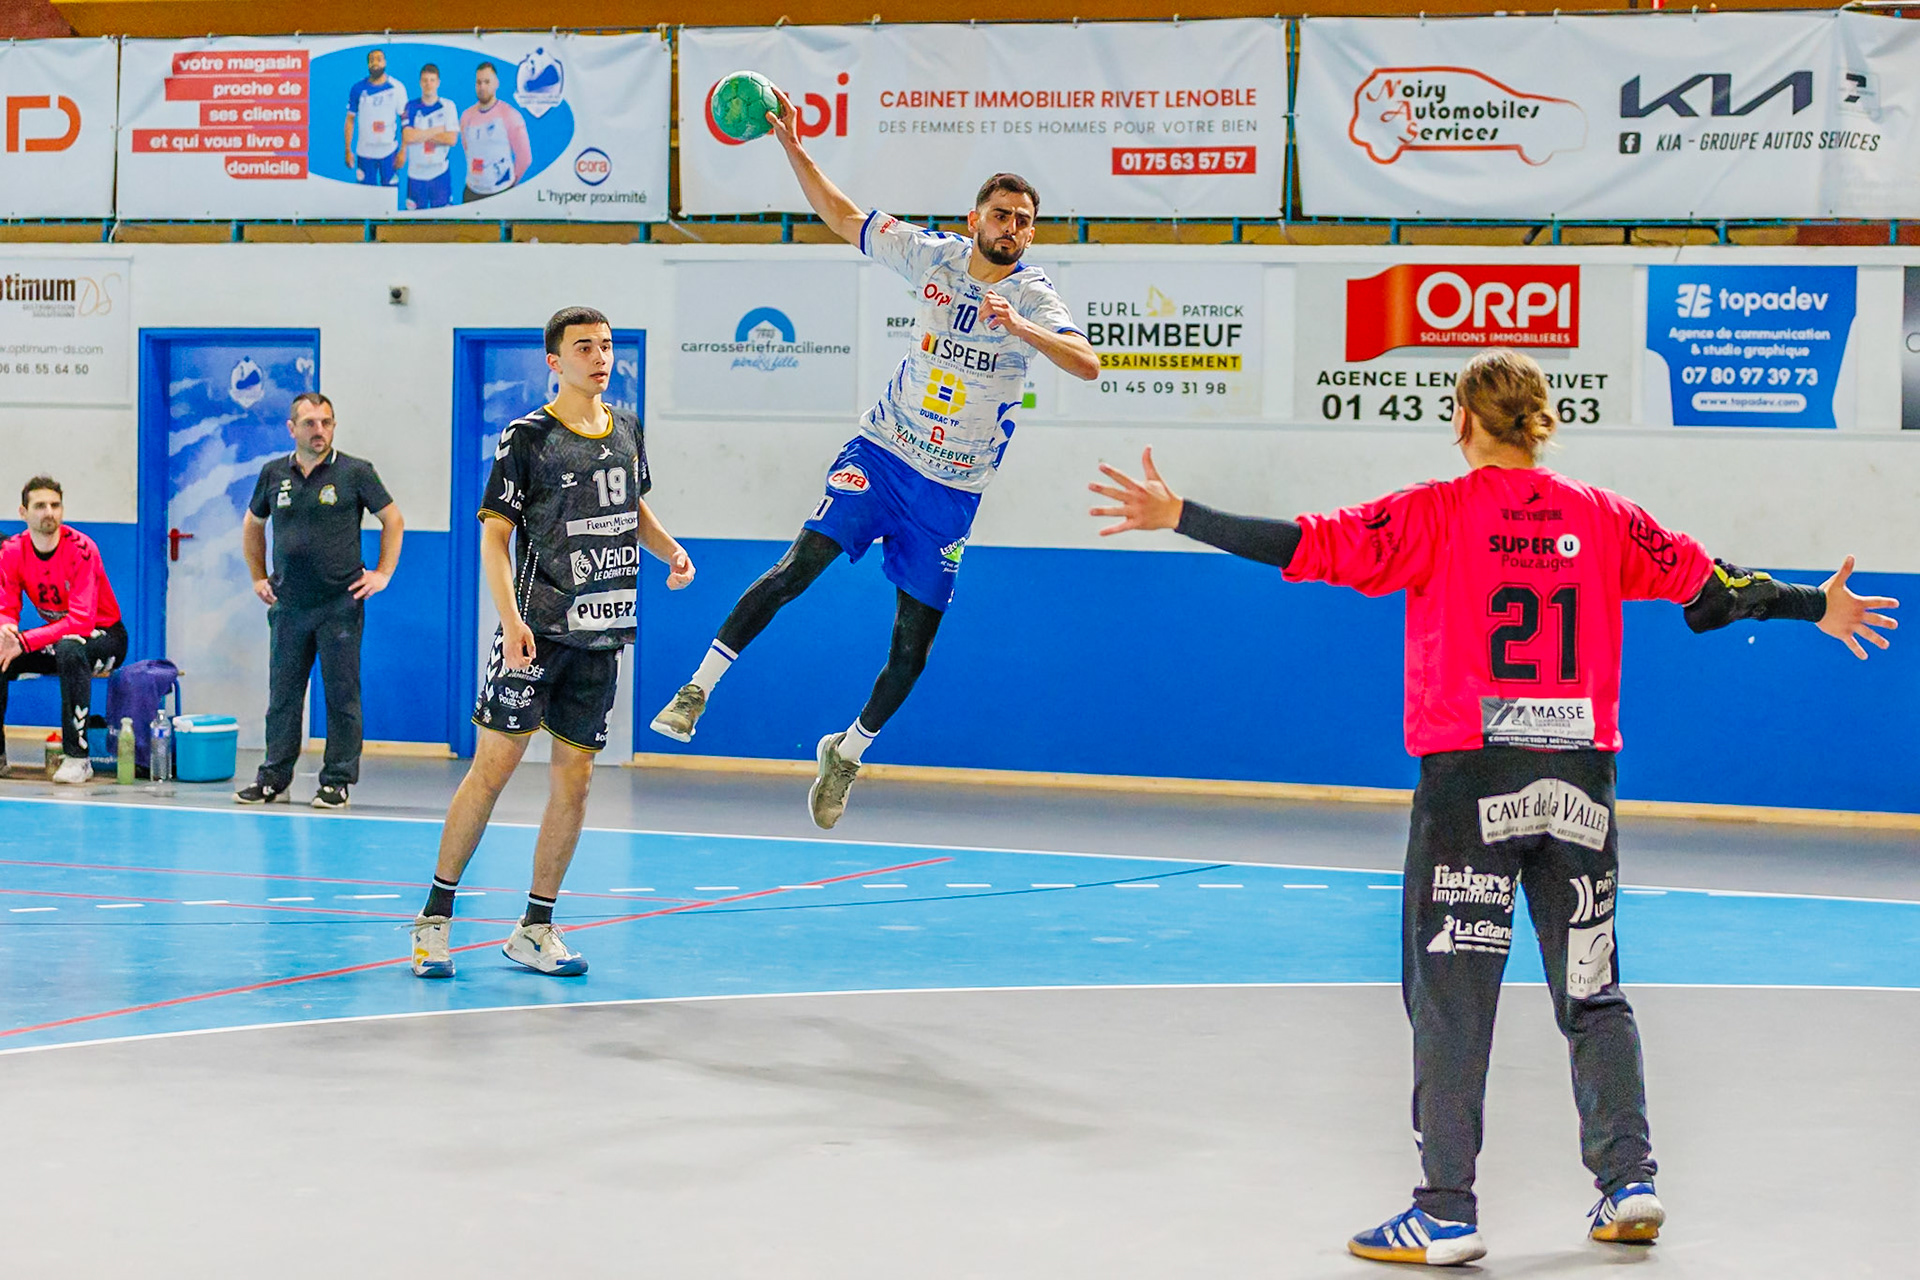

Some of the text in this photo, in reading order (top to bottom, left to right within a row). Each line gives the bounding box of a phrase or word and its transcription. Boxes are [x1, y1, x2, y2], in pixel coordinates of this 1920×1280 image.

[180, 56, 302, 73] votre magasin
[213, 81, 301, 98] proche de
[880, 88, 1257, 108] CABINET IMMOBILIER RIVET LENOBLE
[1366, 79, 1446, 103] Noisy
[209, 106, 301, 121] ses clients
[1380, 100, 1539, 122] Automobiles
[879, 119, 1257, 133] DES FEMMES ET DES HOMMES POUR VOTRE BIEN
[1397, 122, 1498, 144] Services
[150, 132, 300, 151] et qui vous livre à
[1656, 133, 1682, 151] KIA
[1700, 132, 1758, 150] GROUPE
[1763, 131, 1813, 149] AUTOS
[1818, 131, 1881, 151] SEVICES
[227, 160, 300, 175] domicile
[577, 160, 608, 172] cora
[1121, 151, 1247, 170] 01 75 63 57 57
[537, 189, 647, 205] L'hyper proximité
[0, 273, 76, 302] timum
[1088, 303, 1244, 317] EURL PATRICK
[1416, 271, 1571, 330] ORPI
[1719, 286, 1829, 317] topadev
[953, 303, 978, 334] 10
[1089, 323, 1242, 347] BRIMBEUF
[1420, 331, 1486, 343] SOLUTIONS
[1669, 327, 1831, 342] Agence de communication
[940, 338, 999, 373] SPEBI
[1691, 343, 1810, 360] & studio graphique
[1101, 355, 1241, 369] SSAINISSEMENT
[1317, 371, 1408, 387] AGENCE
[1416, 371, 1457, 388] LEN
[1682, 366, 1819, 386] 07 80 97 39 73
[1101, 381, 1227, 394] 01 45 09 31 98
[1322, 394, 1600, 424] 01 43 3 63
[1700, 396, 1800, 408] www.topadev.com
[920, 409, 960, 428] DUBRAC TP
[919, 440, 976, 465] LEFEBVRE
[592, 467, 627, 508] 19
[832, 472, 867, 489] cora
[1489, 535, 1574, 555] SUPER U
[1502, 554, 1574, 573] Pouzauges
[594, 572, 604, 582] LE
[38, 583, 62, 605] 23
[1487, 582, 1581, 685] 21
[1487, 797, 1530, 823] CAVE
[1534, 793, 1547, 817] de
[1547, 792, 1559, 817] la
[1434, 865, 1511, 893] liaigre
[1433, 887, 1511, 906] imprimerie
[1455, 919, 1473, 935] La
